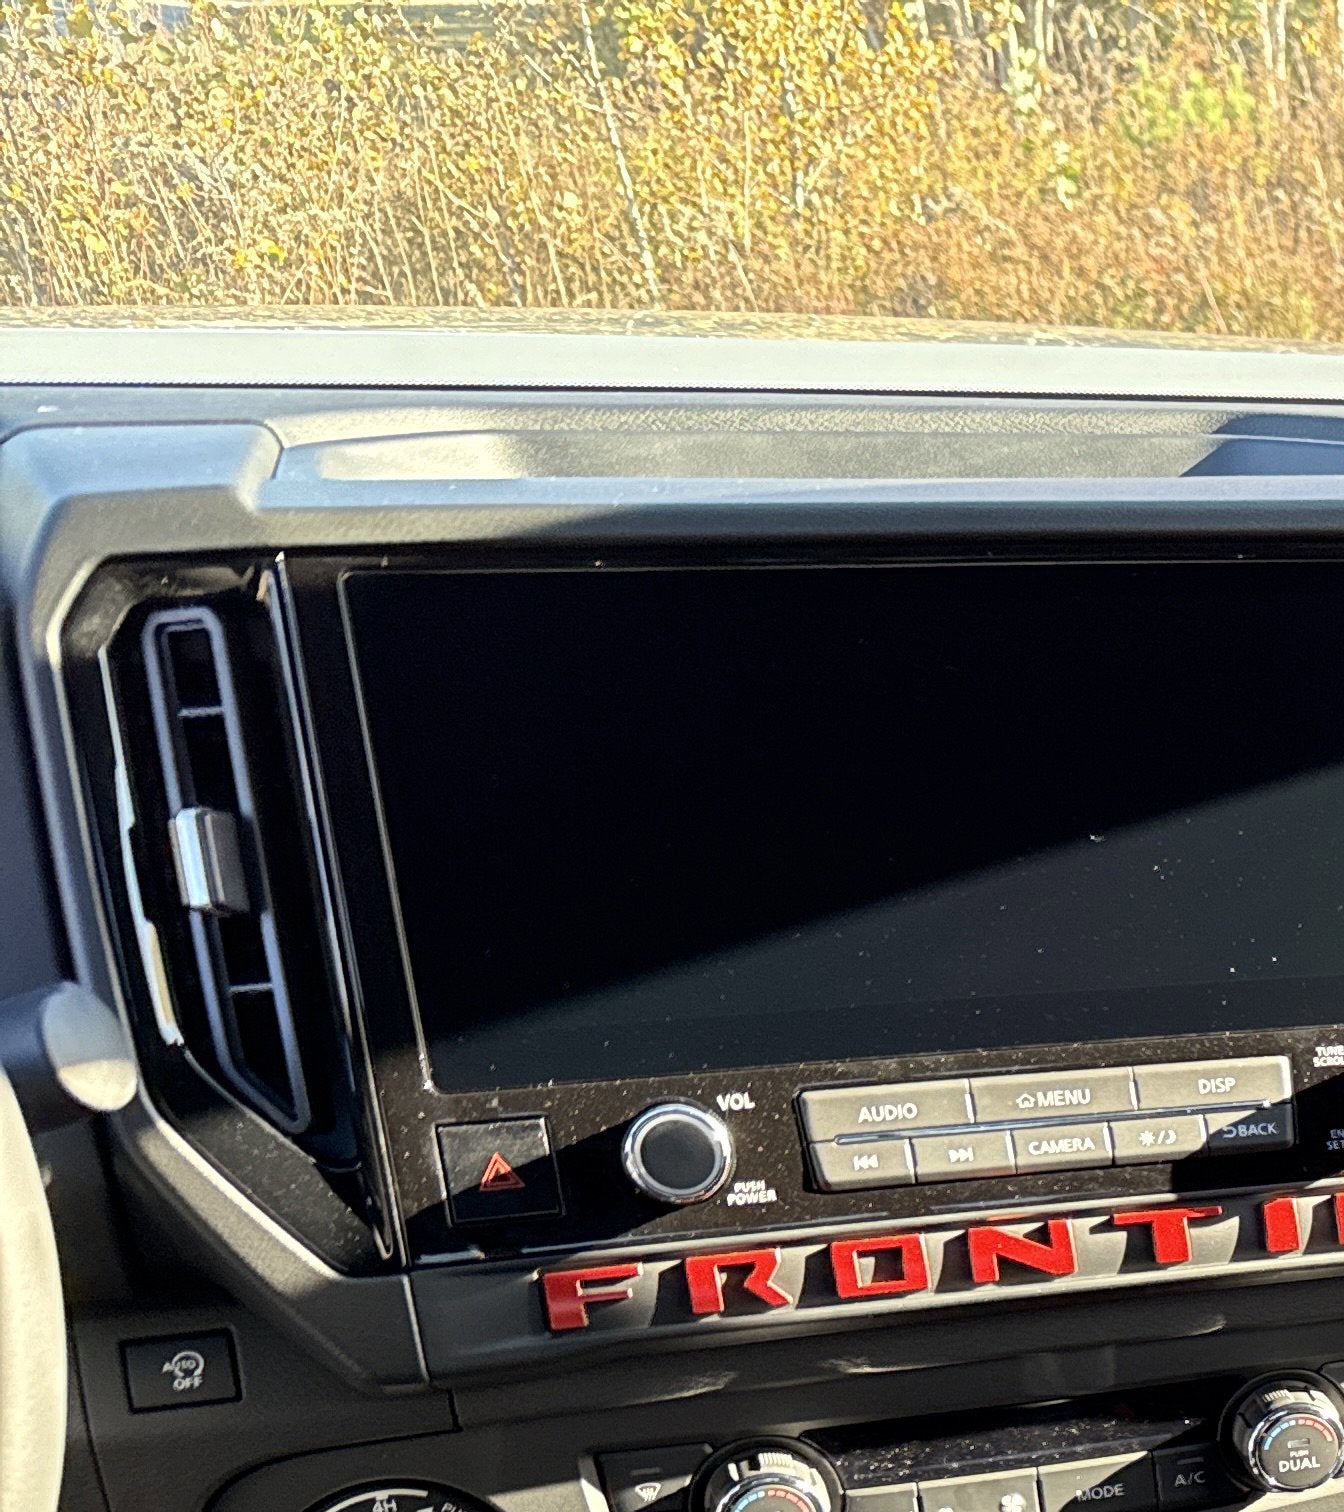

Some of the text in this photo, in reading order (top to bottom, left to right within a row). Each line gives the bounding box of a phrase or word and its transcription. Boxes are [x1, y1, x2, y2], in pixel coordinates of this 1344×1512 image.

[1198, 1077, 1236, 1095] DISP
[716, 1092, 756, 1112] VOL
[1036, 1088, 1091, 1108] MENU
[857, 1101, 918, 1123] AUDIO
[1237, 1122, 1279, 1138] BACK
[1028, 1136, 1096, 1156] CAMERA
[734, 1180, 766, 1193] PUSH
[727, 1189, 778, 1207] POWER
[173, 1377, 203, 1391] OFF
[1279, 1456, 1320, 1474] DUAL
[1174, 1471, 1206, 1488] A/C
[1076, 1483, 1126, 1502] MODE
